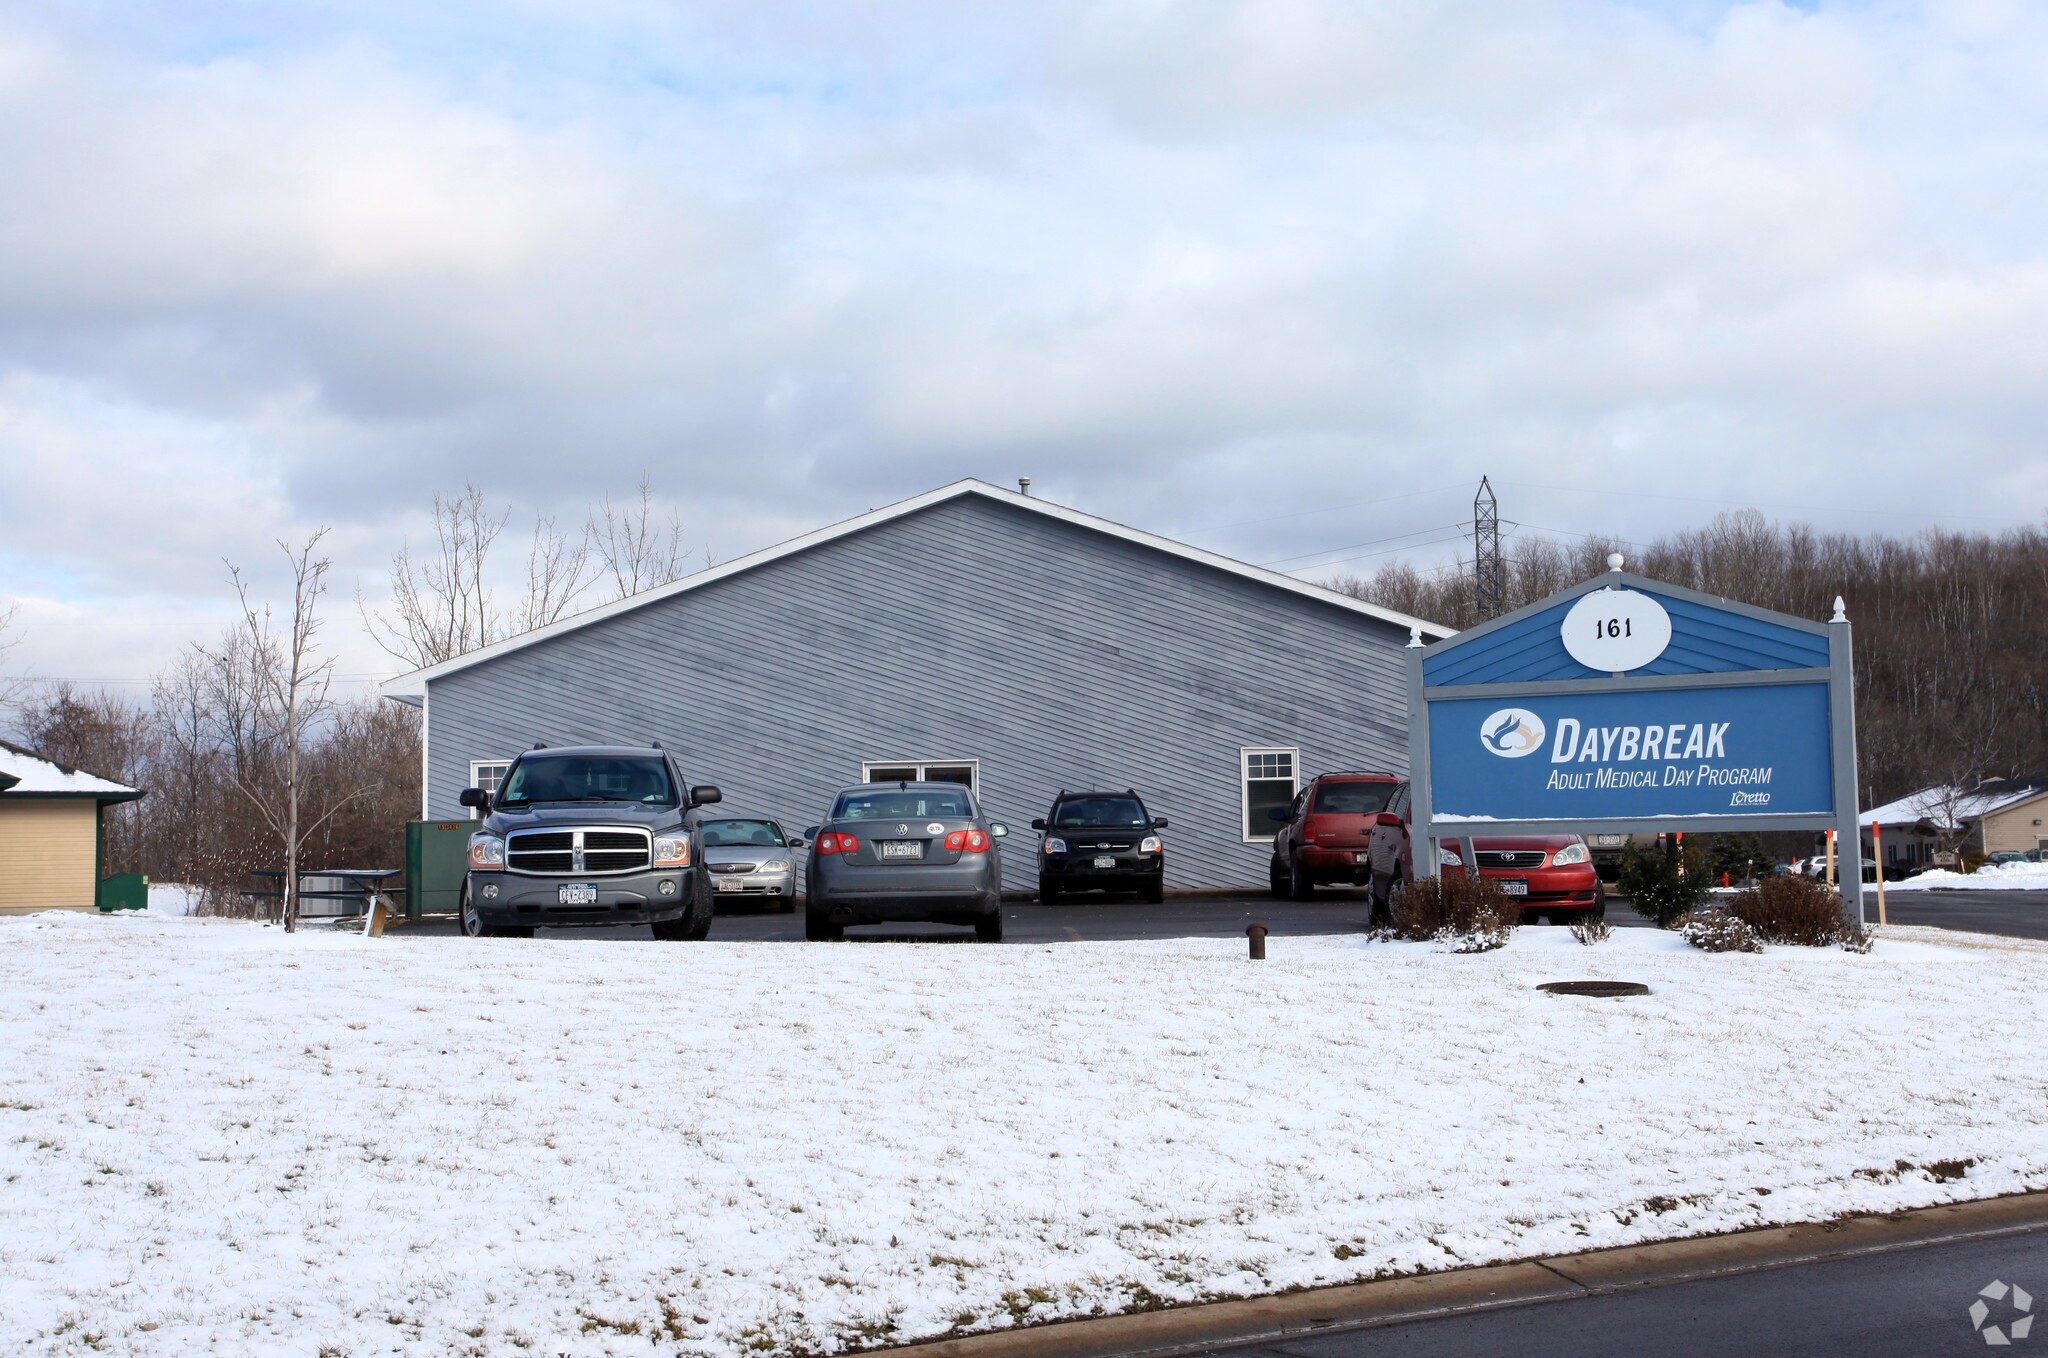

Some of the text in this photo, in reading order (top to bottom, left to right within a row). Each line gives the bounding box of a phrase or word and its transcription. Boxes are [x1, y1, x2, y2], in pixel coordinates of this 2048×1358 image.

[1596, 617, 1632, 640] 161
[1551, 718, 1731, 763] DAYBREAK
[1546, 764, 1772, 790] ADULT MEDICAL DAY PROGRAM
[1729, 790, 1771, 807] Loretto
